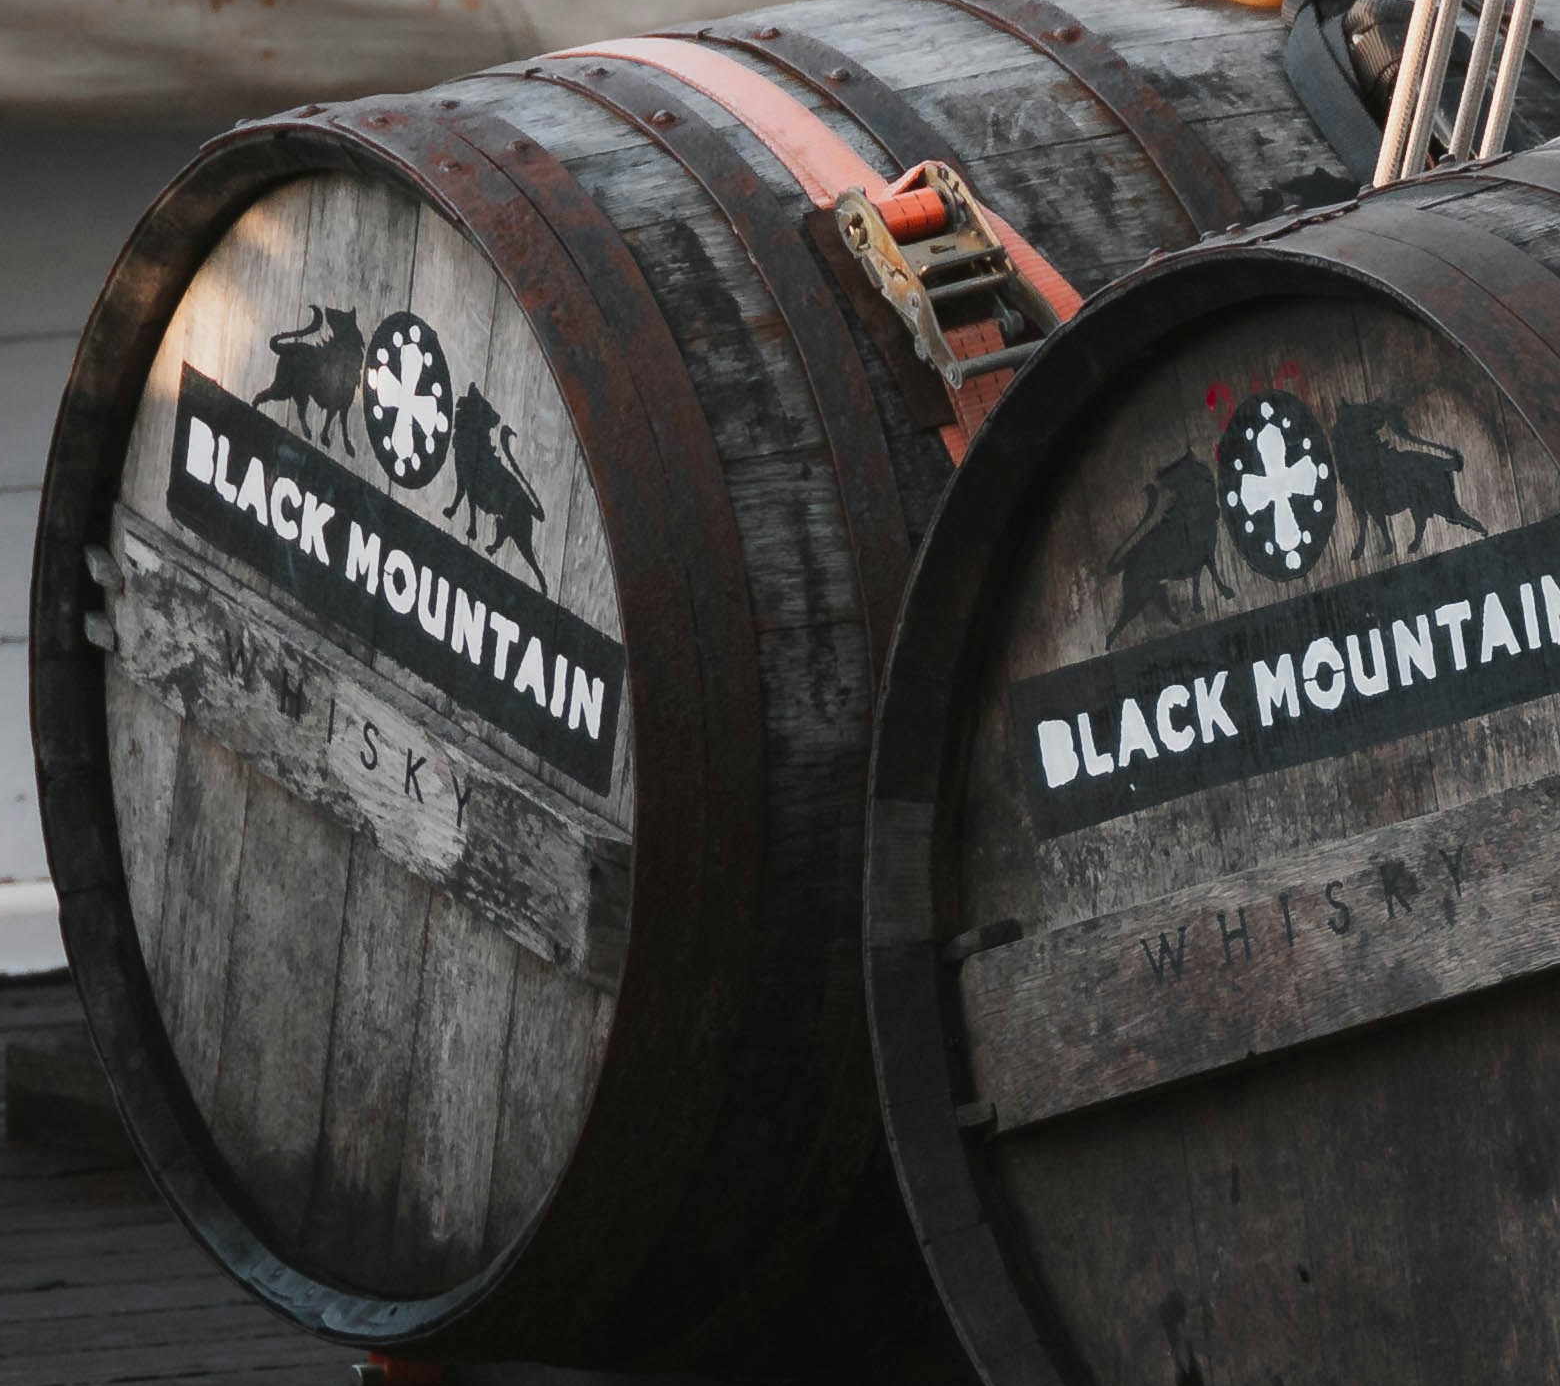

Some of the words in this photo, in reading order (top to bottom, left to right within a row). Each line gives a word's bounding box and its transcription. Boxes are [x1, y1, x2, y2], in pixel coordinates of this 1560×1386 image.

[184, 416, 330, 566] BLACK
[345, 521, 605, 740] MOUNTAIN
[223, 625, 472, 828] WHISKY
[1037, 670, 1238, 790] BLACK
[1139, 843, 1466, 986] WHISKY
